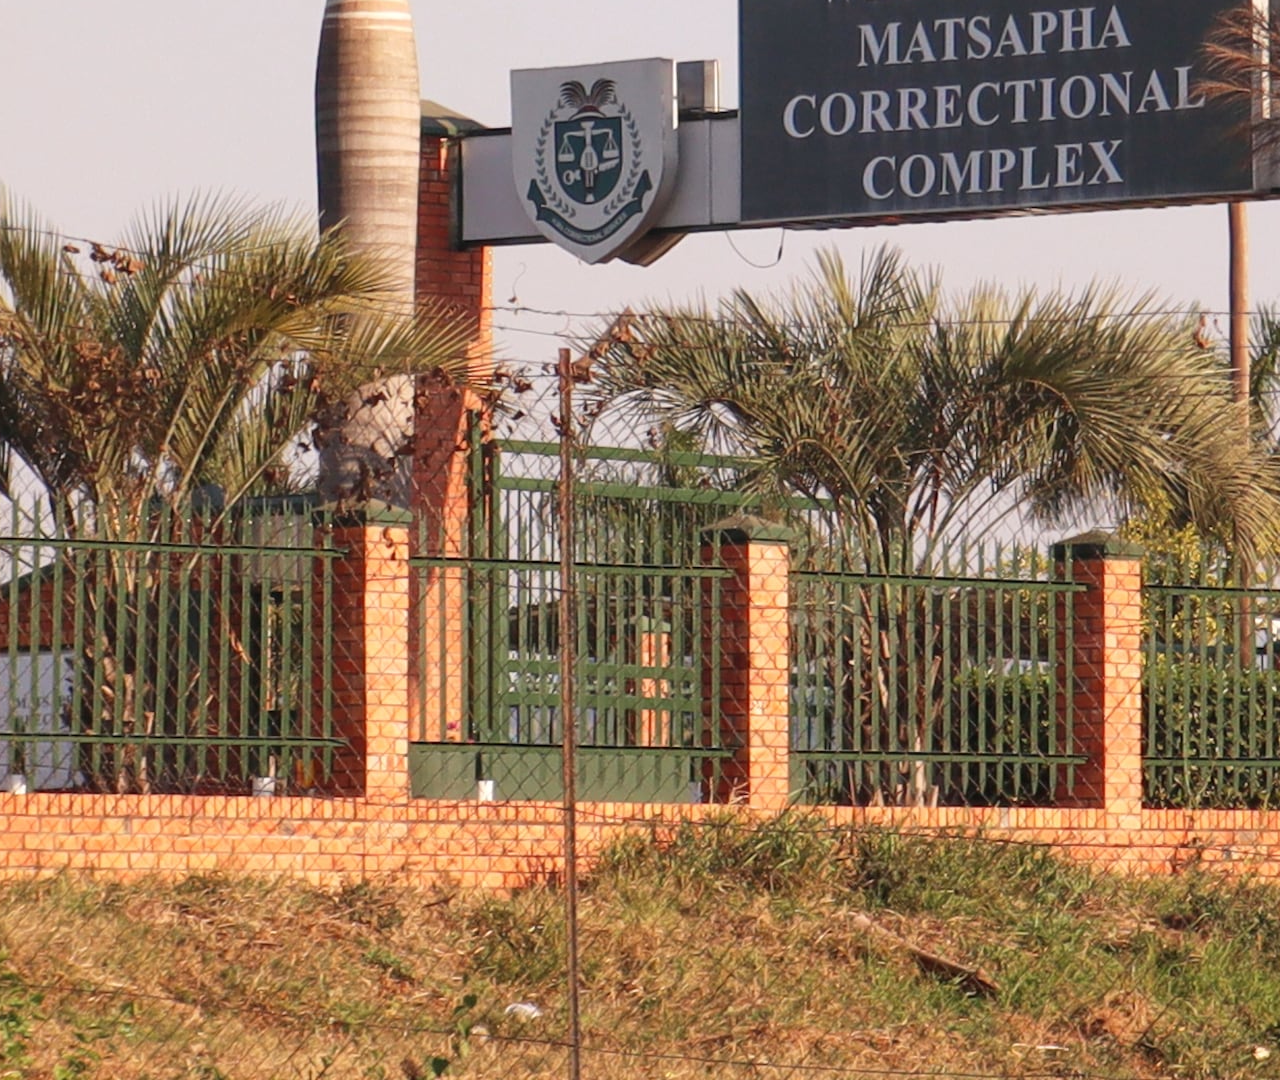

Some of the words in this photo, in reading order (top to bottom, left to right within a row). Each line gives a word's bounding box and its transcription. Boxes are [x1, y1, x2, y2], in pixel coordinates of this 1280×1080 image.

[857, 5, 1132, 67] MATSAPHA
[783, 66, 1207, 138] CORRECTIONAL
[862, 139, 1123, 199] COMPLEX
